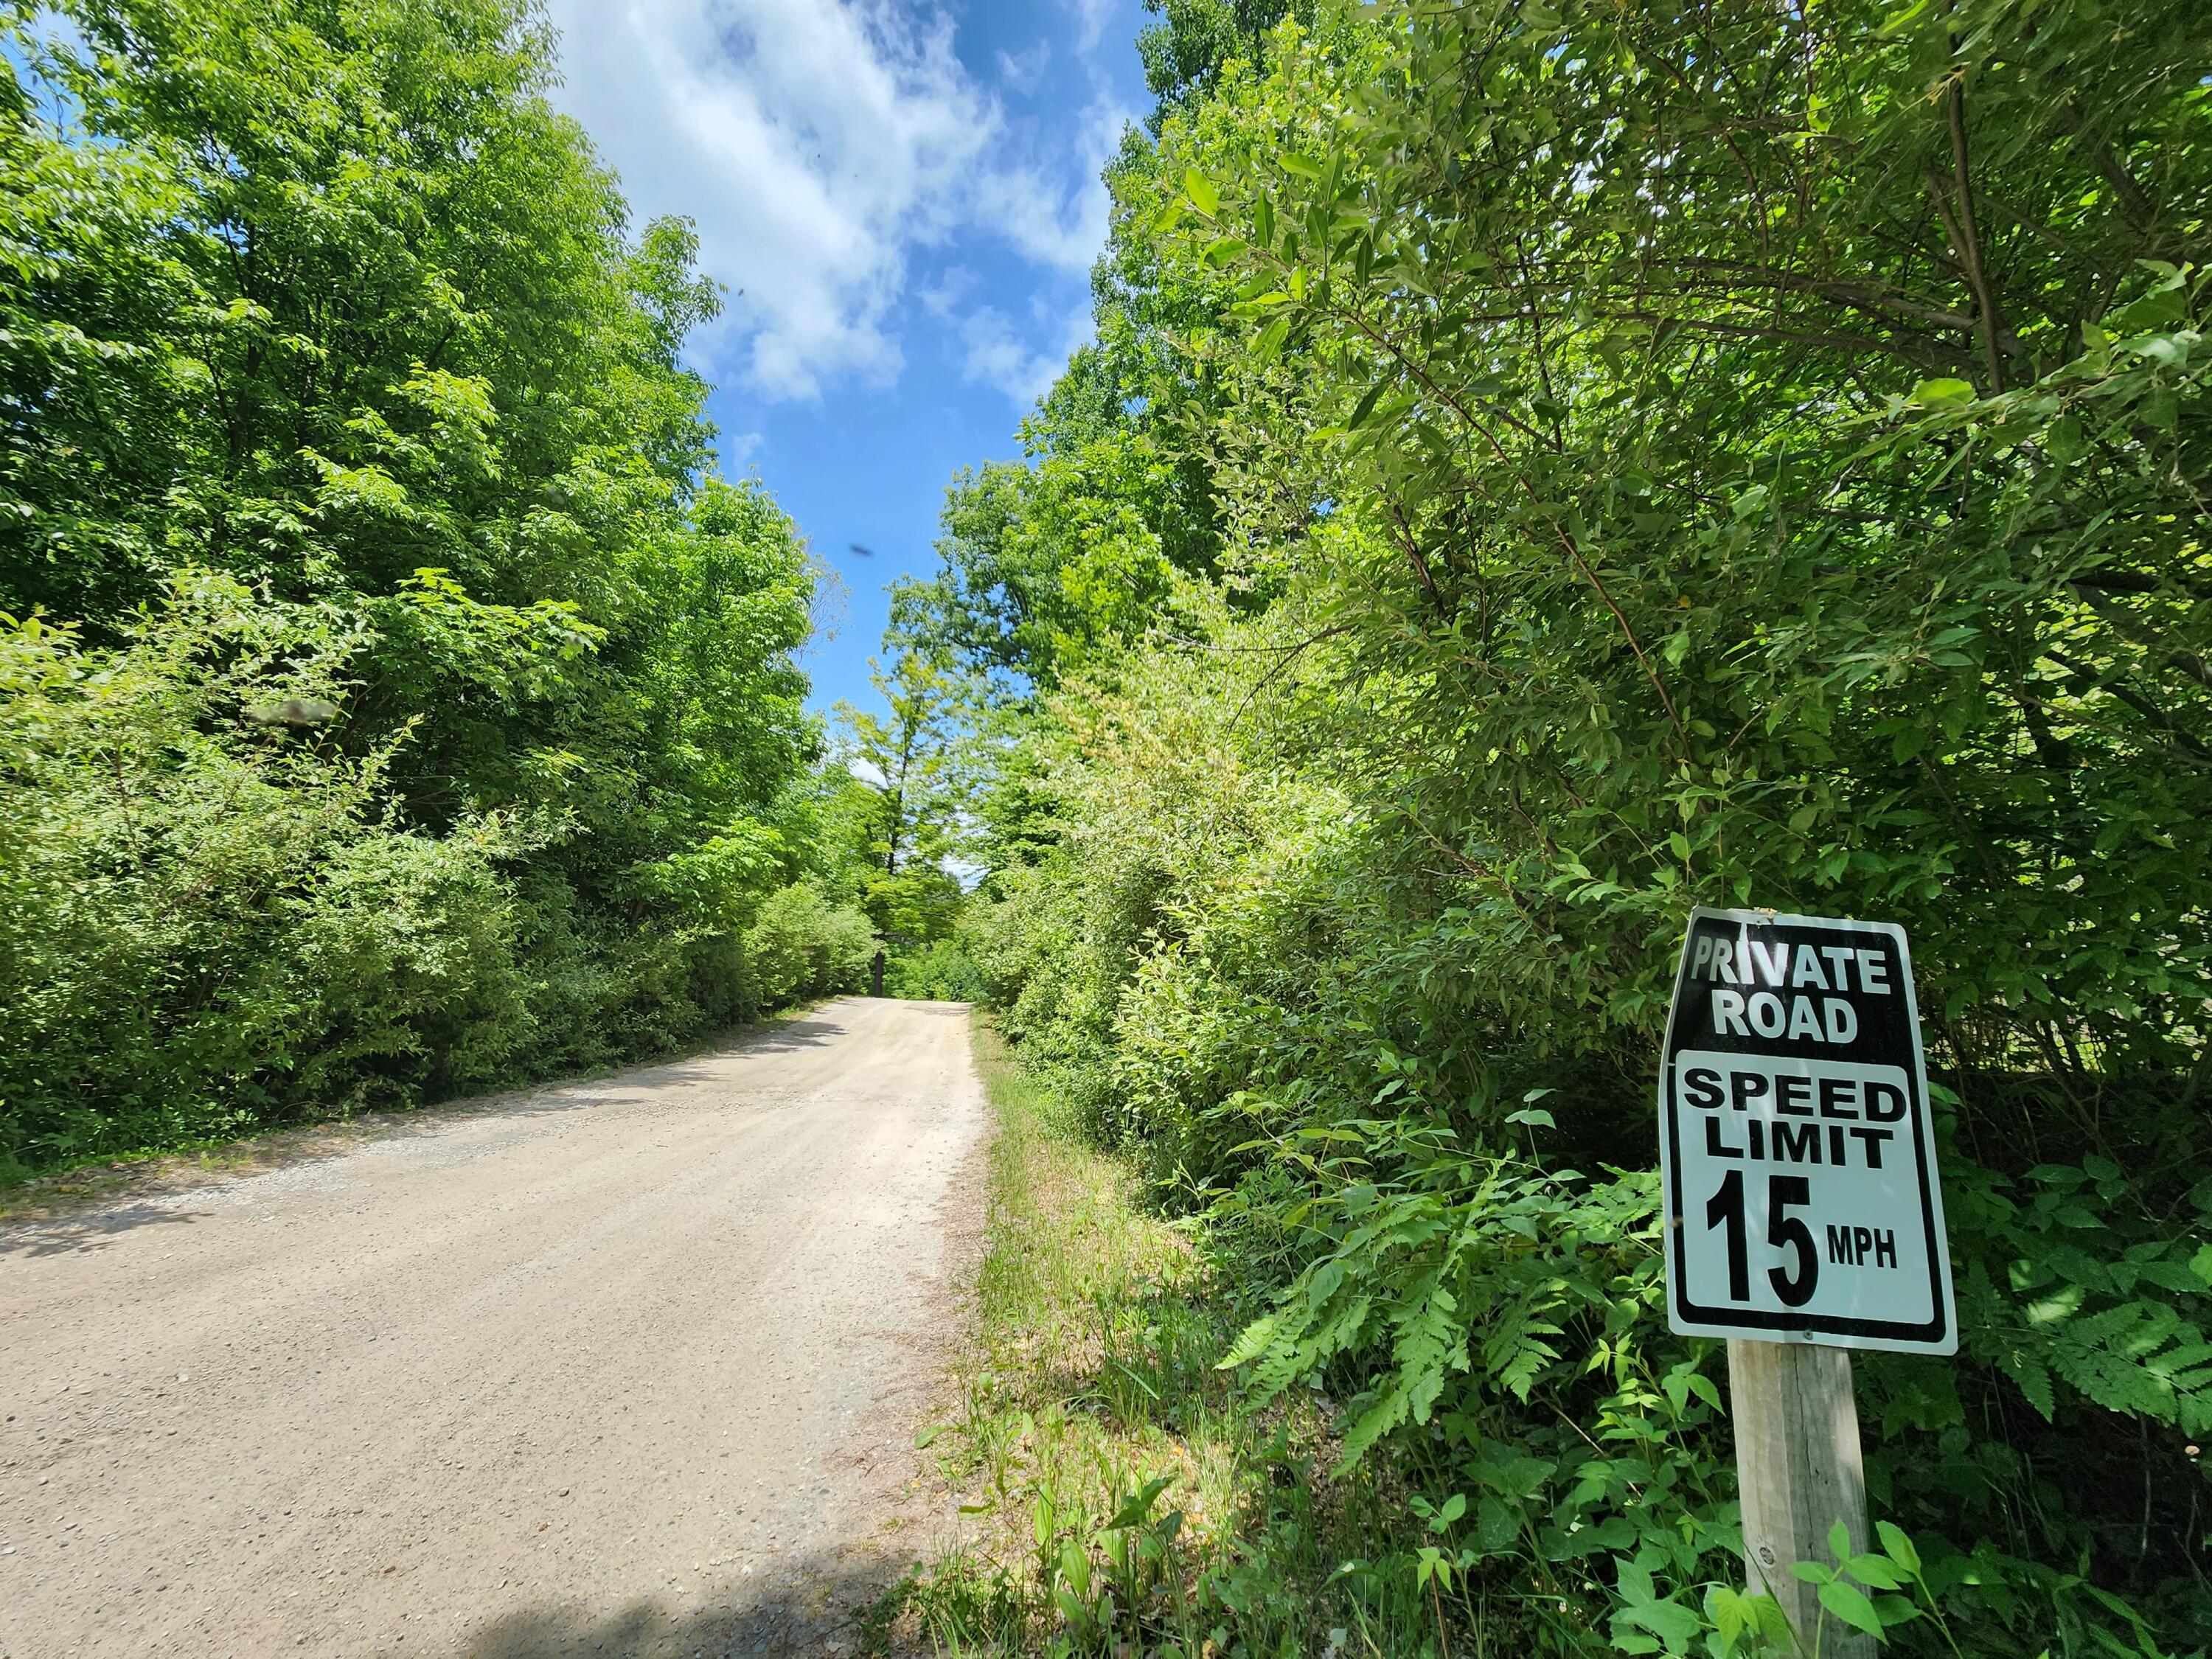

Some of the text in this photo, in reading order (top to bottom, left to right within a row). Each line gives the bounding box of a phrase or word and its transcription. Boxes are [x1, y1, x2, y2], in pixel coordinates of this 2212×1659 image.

[1691, 936, 1891, 995] PRIVATE
[1711, 990, 1857, 1043] ROAD
[1684, 1068, 1907, 1122] SPEED
[1705, 1116, 1893, 1169] LIMIT
[1706, 1169, 1898, 1307] 15 MPH
